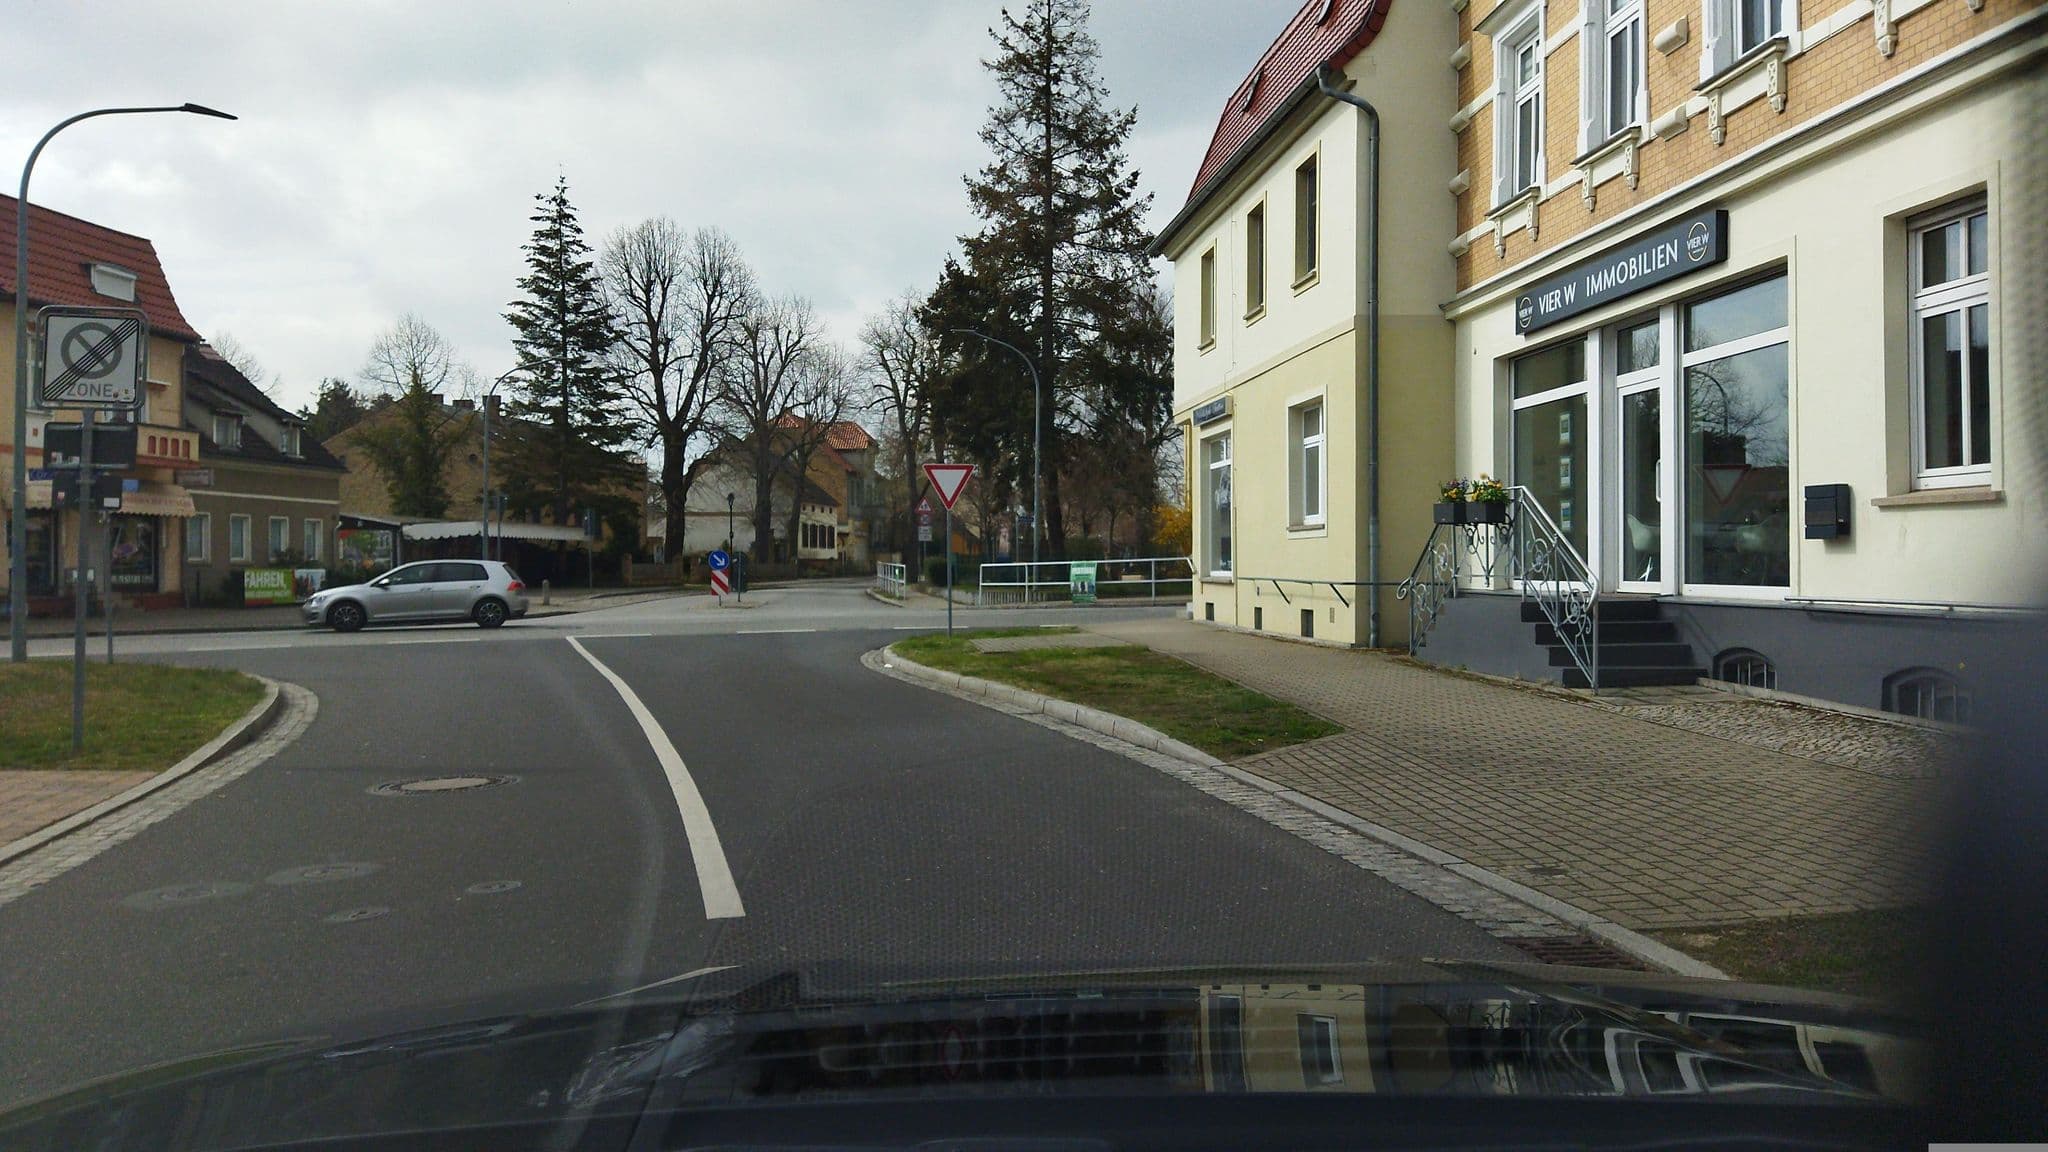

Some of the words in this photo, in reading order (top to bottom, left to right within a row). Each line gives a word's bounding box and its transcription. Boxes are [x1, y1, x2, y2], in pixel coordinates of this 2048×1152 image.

[1686, 236, 1701, 251] VIER
[1701, 232, 1710, 244] W
[1538, 289, 1562, 316] VIER
[1563, 282, 1577, 306] W
[1586, 239, 1678, 297] IMMOBILIEN
[66, 382, 113, 398] ZONE
